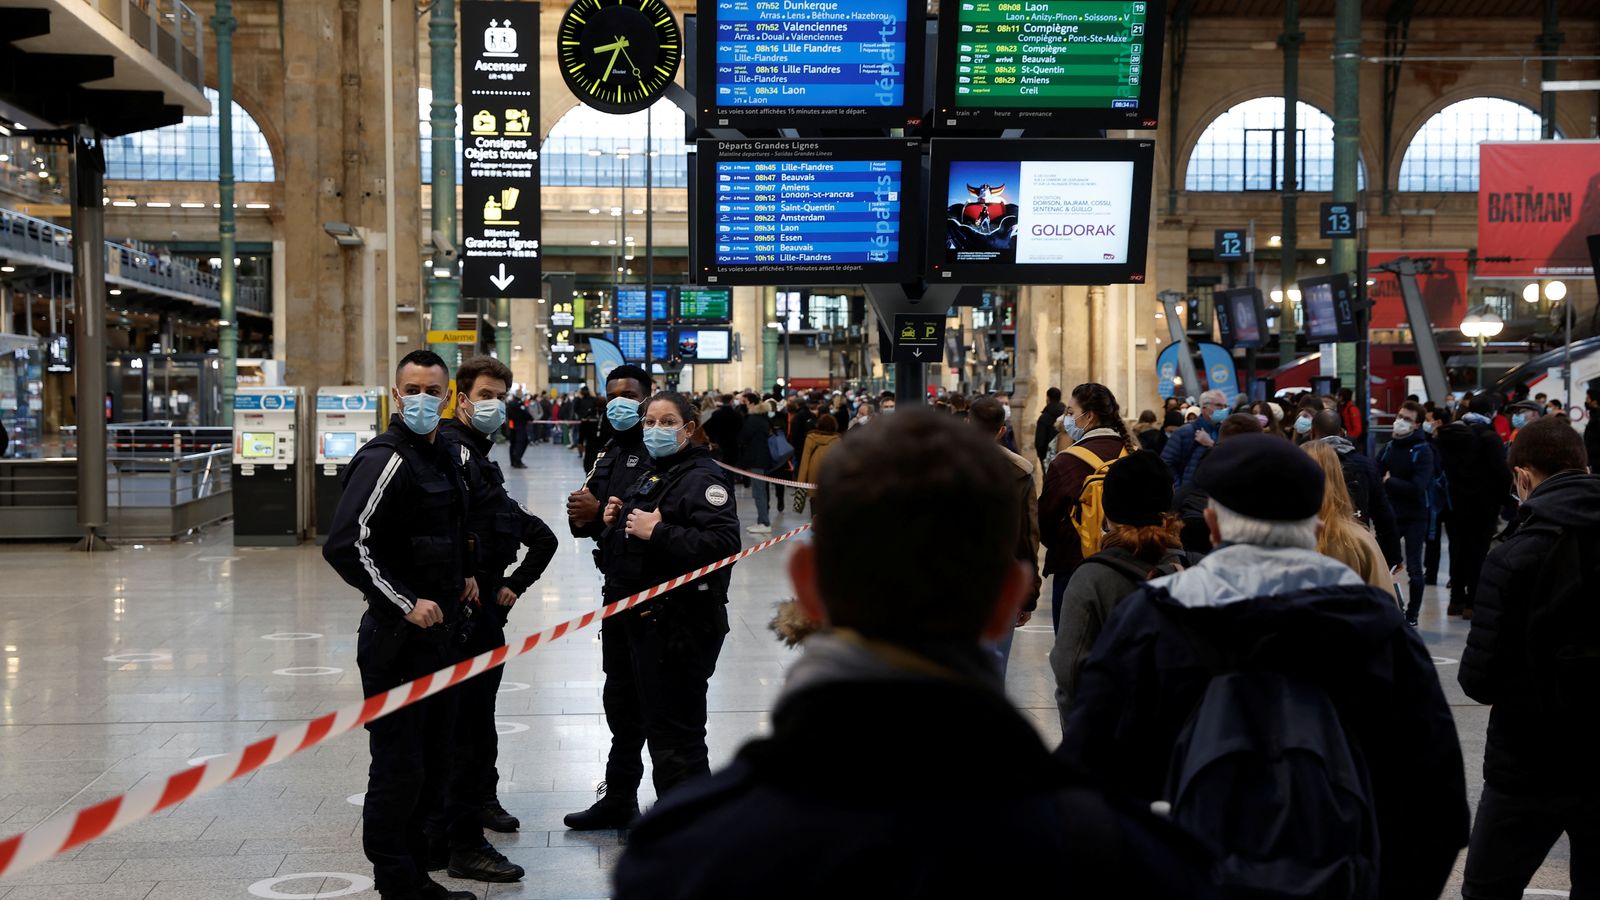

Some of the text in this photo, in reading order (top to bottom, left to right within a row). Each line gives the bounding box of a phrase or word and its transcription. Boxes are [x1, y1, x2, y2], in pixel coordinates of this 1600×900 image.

[783, 0, 838, 12] Dunkerque
[1025, 2, 1049, 11] Laon
[1135, 4, 1145, 12] 19
[760, 12, 780, 20] Arras
[787, 12, 805, 20] Lens
[812, 12, 845, 20] Béthune
[1005, 13, 1025, 21] Laon
[1030, 13, 1078, 22] Anizy-Pinon
[1084, 13, 1117, 21] Soissons
[756, 24, 779, 32] 07h52
[783, 22, 848, 32] Valenciennes
[997, 25, 1020, 33] 08h11
[1023, 23, 1079, 35] Compiègne
[1132, 25, 1142, 33] 21
[735, 33, 843, 41] Arras Douai Valenciennes
[1018, 34, 1127, 44] Compiègne Pont-Ste-Maxe
[783, 43, 801, 53] Lille
[803, 43, 842, 53] Flandres
[1022, 44, 1067, 54] Compiègne
[734, 54, 788, 62] Lille-Flandres
[1022, 55, 1056, 63] Beauvais
[474, 59, 527, 72] Ascenseur
[755, 66, 779, 74] 08h16
[783, 64, 801, 74] Lille
[803, 65, 841, 74] Flandres
[1021, 65, 1064, 74] St-Quentin
[734, 75, 788, 83] Lille-Flandres
[1020, 76, 1050, 84] Amiens
[782, 85, 806, 95] Laon
[1020, 86, 1039, 95] Creil
[748, 96, 768, 104] Laon
[475, 136, 527, 150] Consignes
[719, 141, 819, 151] Départs Grandes Lignes
[464, 148, 538, 161] Objets trouvés
[781, 163, 834, 171] Lille-Flandres
[781, 174, 815, 182] Beauvais
[781, 184, 810, 192] Amiens
[781, 204, 835, 212] Saint-Quentin
[1488, 192, 1572, 223] BATMAN
[781, 214, 825, 222] Amsterdam
[1328, 214, 1351, 231] 13
[484, 228, 520, 238] Billetterie
[781, 224, 799, 232] Laon
[1032, 224, 1116, 236] GOLDORAK
[465, 236, 508, 249] Grandes
[781, 234, 803, 242] Essen
[781, 244, 813, 252] Beauvais
[1221, 239, 1241, 254] 12
[781, 254, 832, 262] Lille-Flandres
[443, 332, 475, 342] Alarme
